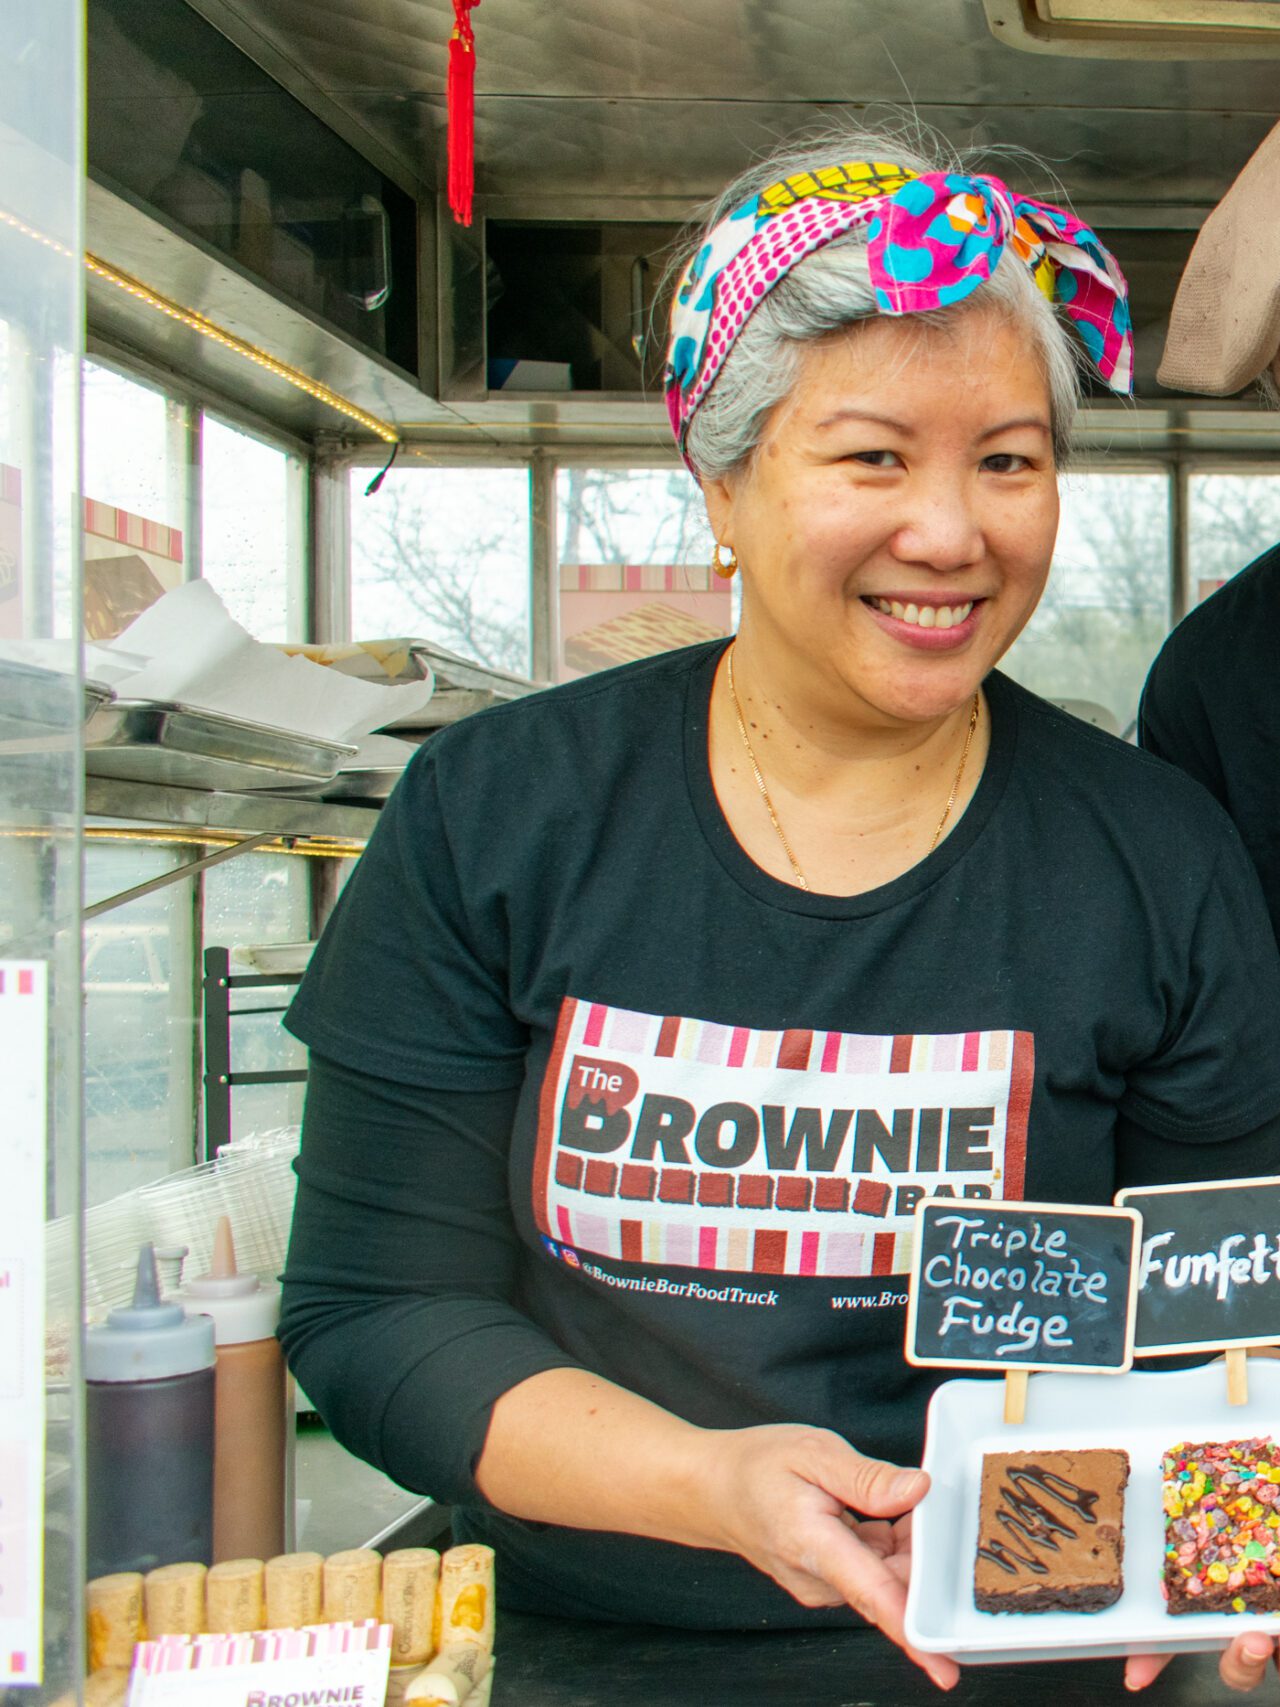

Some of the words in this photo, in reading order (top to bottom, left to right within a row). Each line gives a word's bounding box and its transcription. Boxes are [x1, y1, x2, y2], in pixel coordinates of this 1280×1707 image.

[578, 1065, 623, 1092] The
[558, 1054, 996, 1173] BROWNIE
[934, 1215, 1068, 1259] Triple
[582, 1261, 779, 1306] @BrownieBarFoodTruck
[924, 1251, 1108, 1304] Chocolate
[937, 1295, 1074, 1356] Fudge
